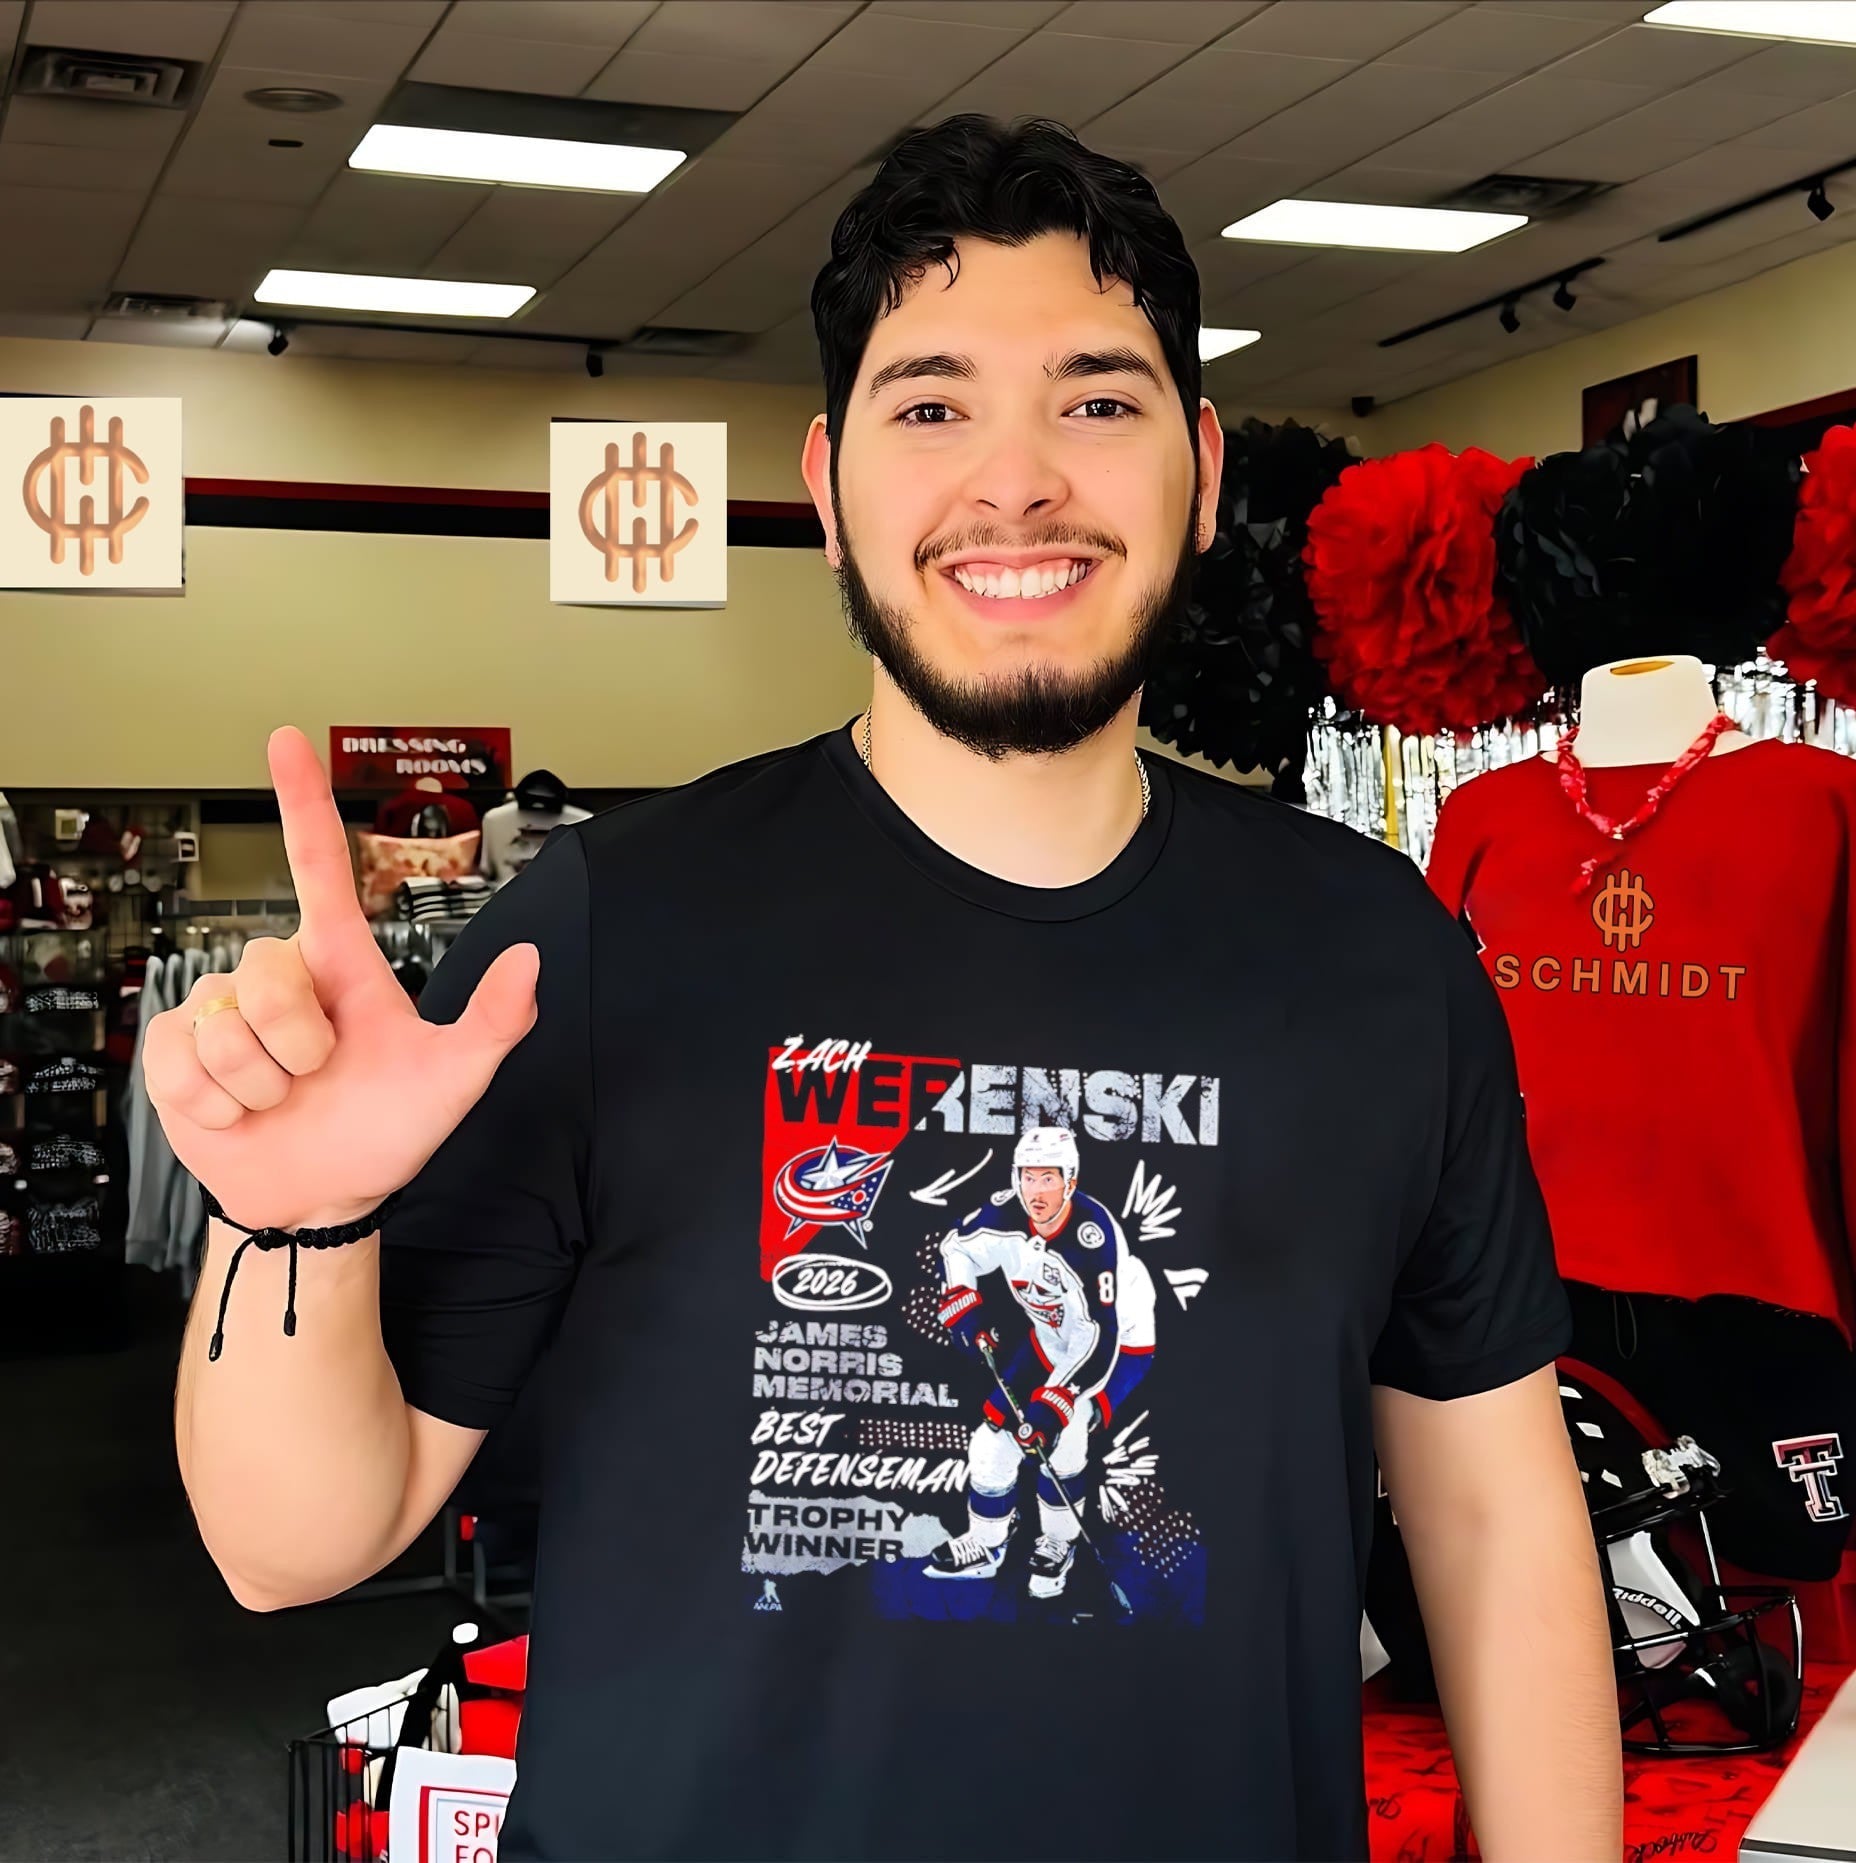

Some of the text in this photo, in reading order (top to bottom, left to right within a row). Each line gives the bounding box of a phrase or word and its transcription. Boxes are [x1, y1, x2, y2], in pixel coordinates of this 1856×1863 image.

[396, 758, 487, 774] ROOMS
[1494, 954, 1746, 999] SCHMIDT
[772, 1034, 872, 1074] ZACH
[776, 1060, 1220, 1147] WERENSKI
[792, 1267, 859, 1296] 2026
[755, 1320, 888, 1349] JAMES
[754, 1347, 903, 1377] NORRIS
[752, 1374, 959, 1407] MEMORIAL
[750, 1406, 846, 1448] BEST
[749, 1449, 972, 1494] DEFENSEMAN
[748, 1502, 908, 1532] TROPHY
[746, 1532, 904, 1562] WINNER
